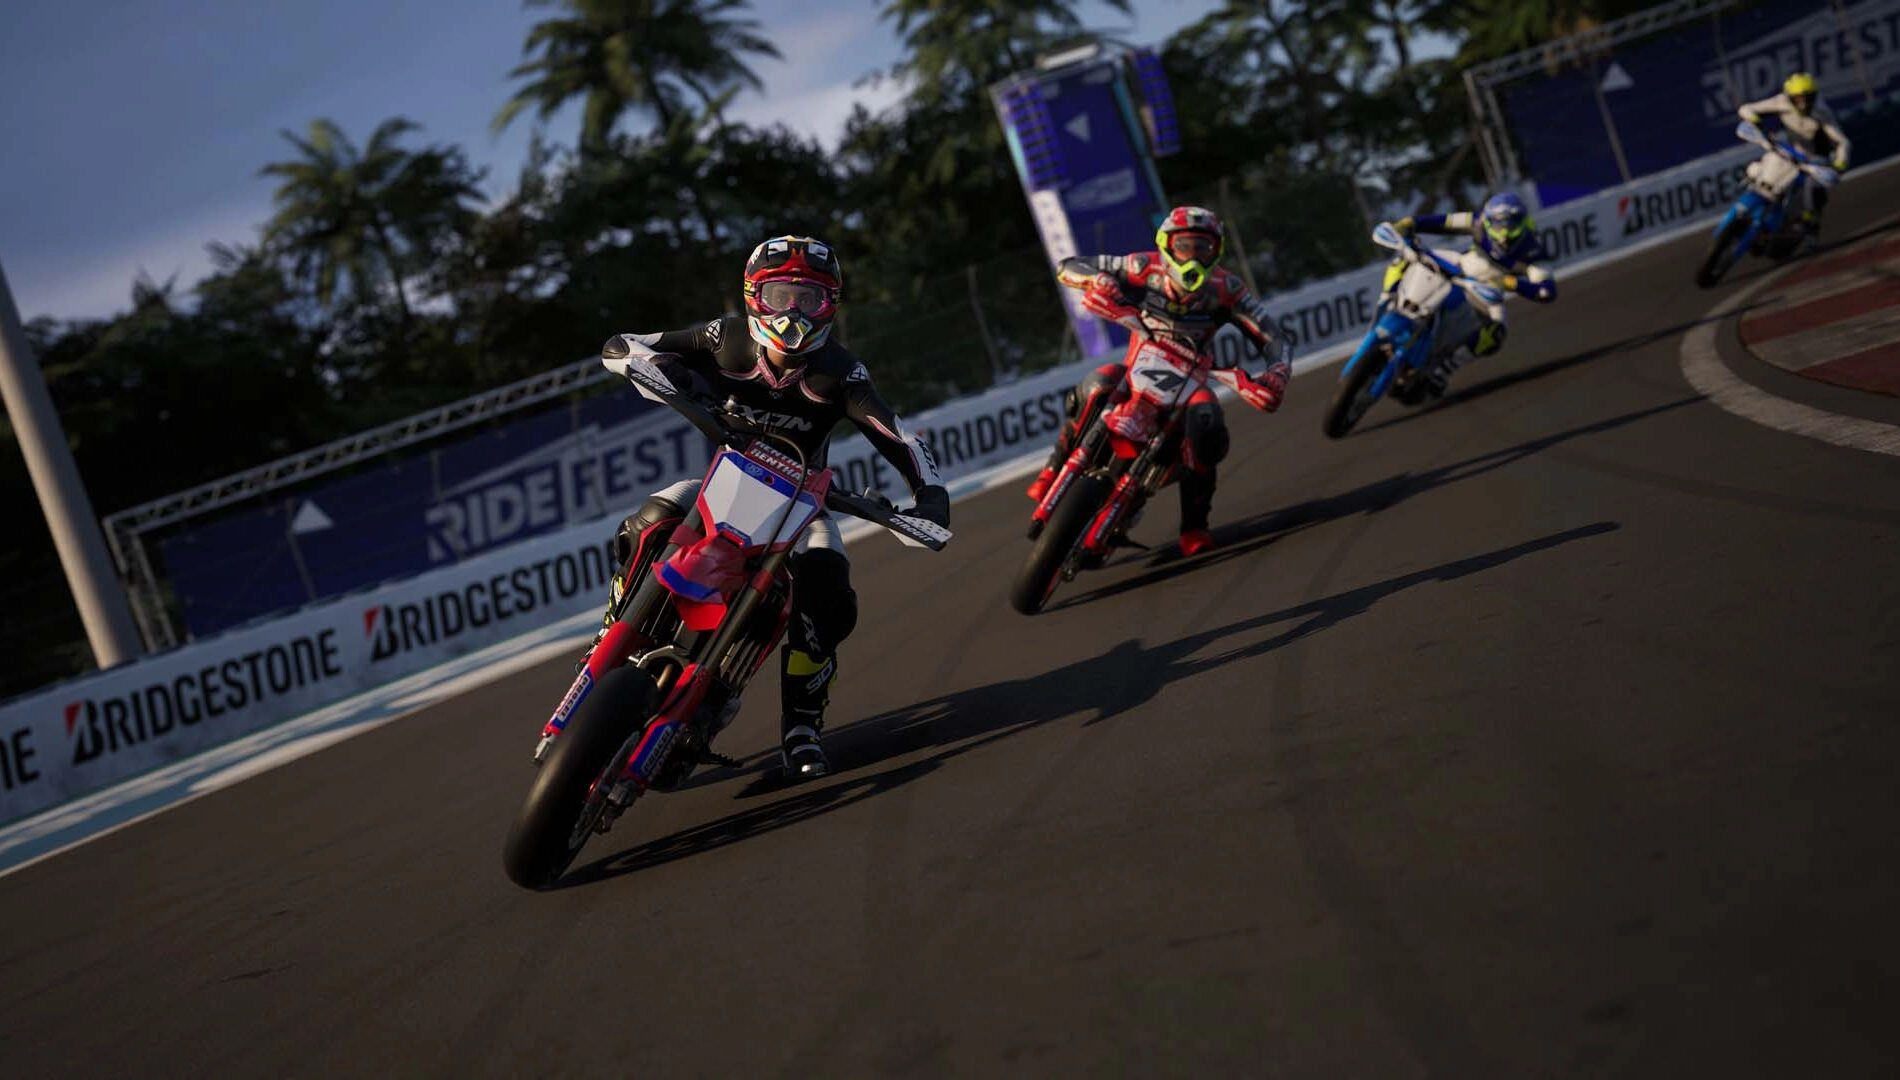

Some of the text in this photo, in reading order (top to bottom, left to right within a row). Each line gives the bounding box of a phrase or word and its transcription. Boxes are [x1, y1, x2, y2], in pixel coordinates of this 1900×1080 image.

[425, 426, 694, 562] RIDE FEST
[749, 448, 806, 483] RENTHA
[64, 628, 342, 764] BRIDGESTONE
